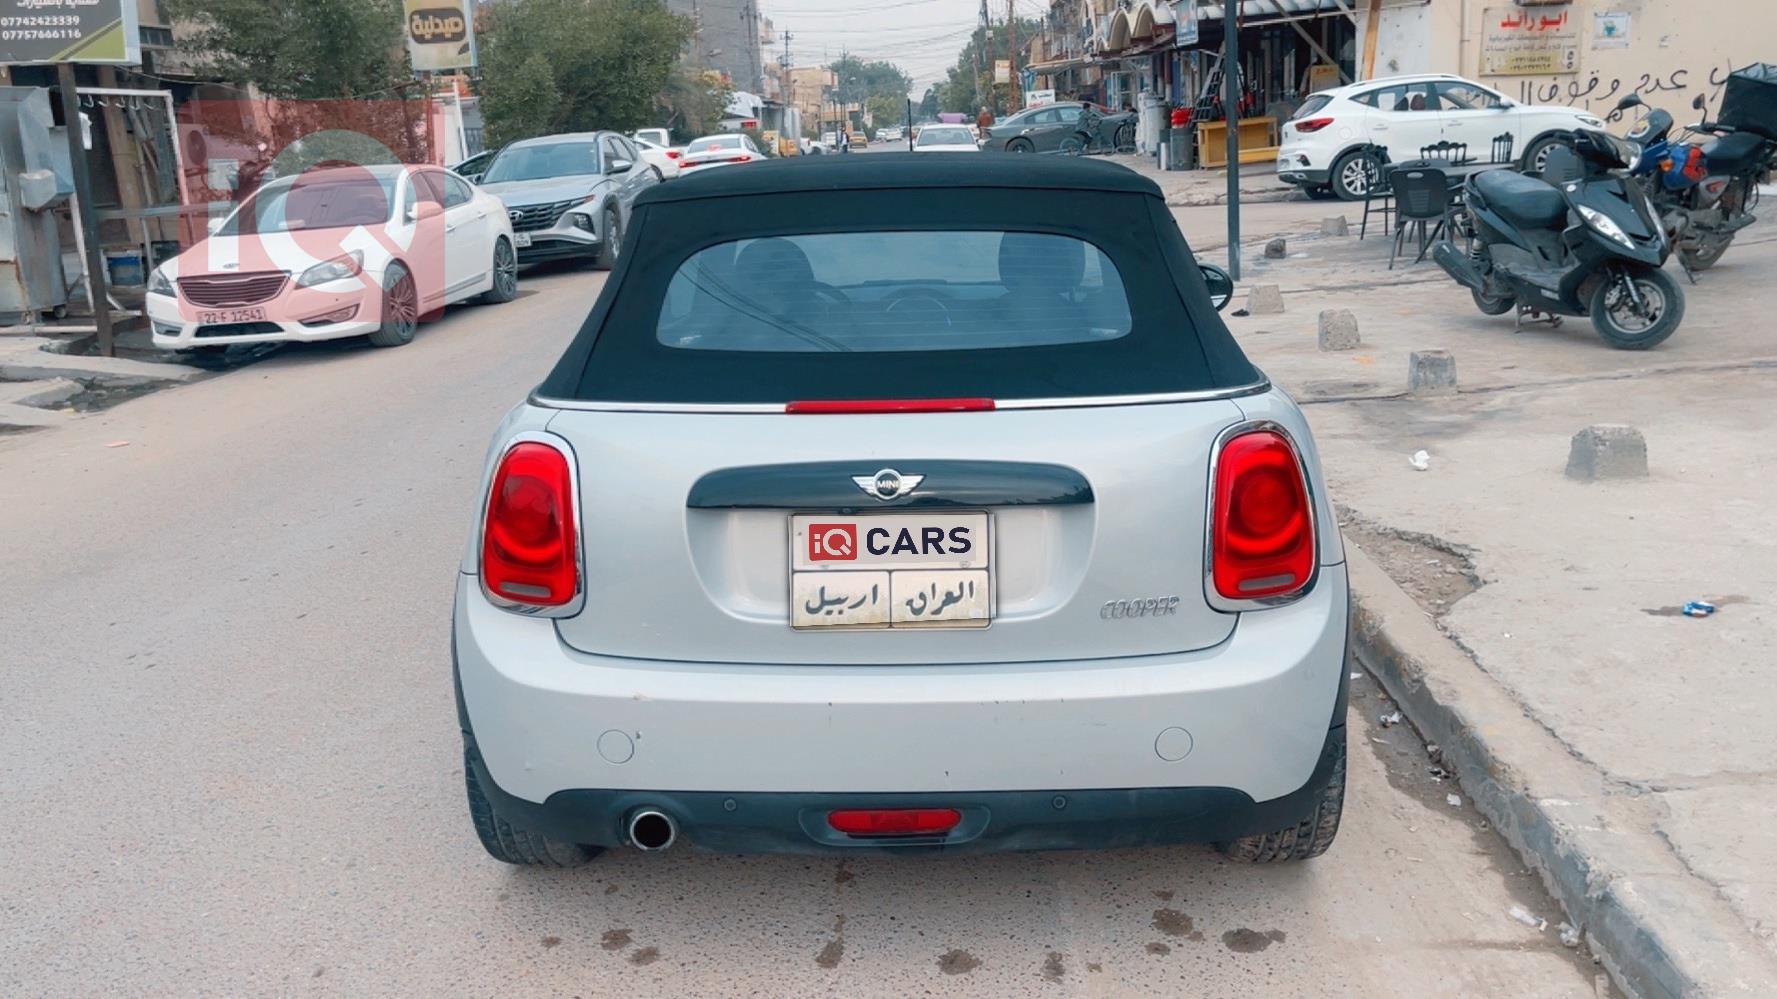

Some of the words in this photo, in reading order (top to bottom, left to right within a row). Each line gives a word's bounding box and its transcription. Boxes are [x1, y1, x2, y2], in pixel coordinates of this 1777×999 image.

[0, 15, 80, 27] 07742423339
[411, 15, 464, 39] صيدلية
[877, 479, 899, 489] MINI
[805, 583, 878, 615] اربيل
[906, 580, 974, 616] العراق
[1100, 595, 1180, 620] COOPER
